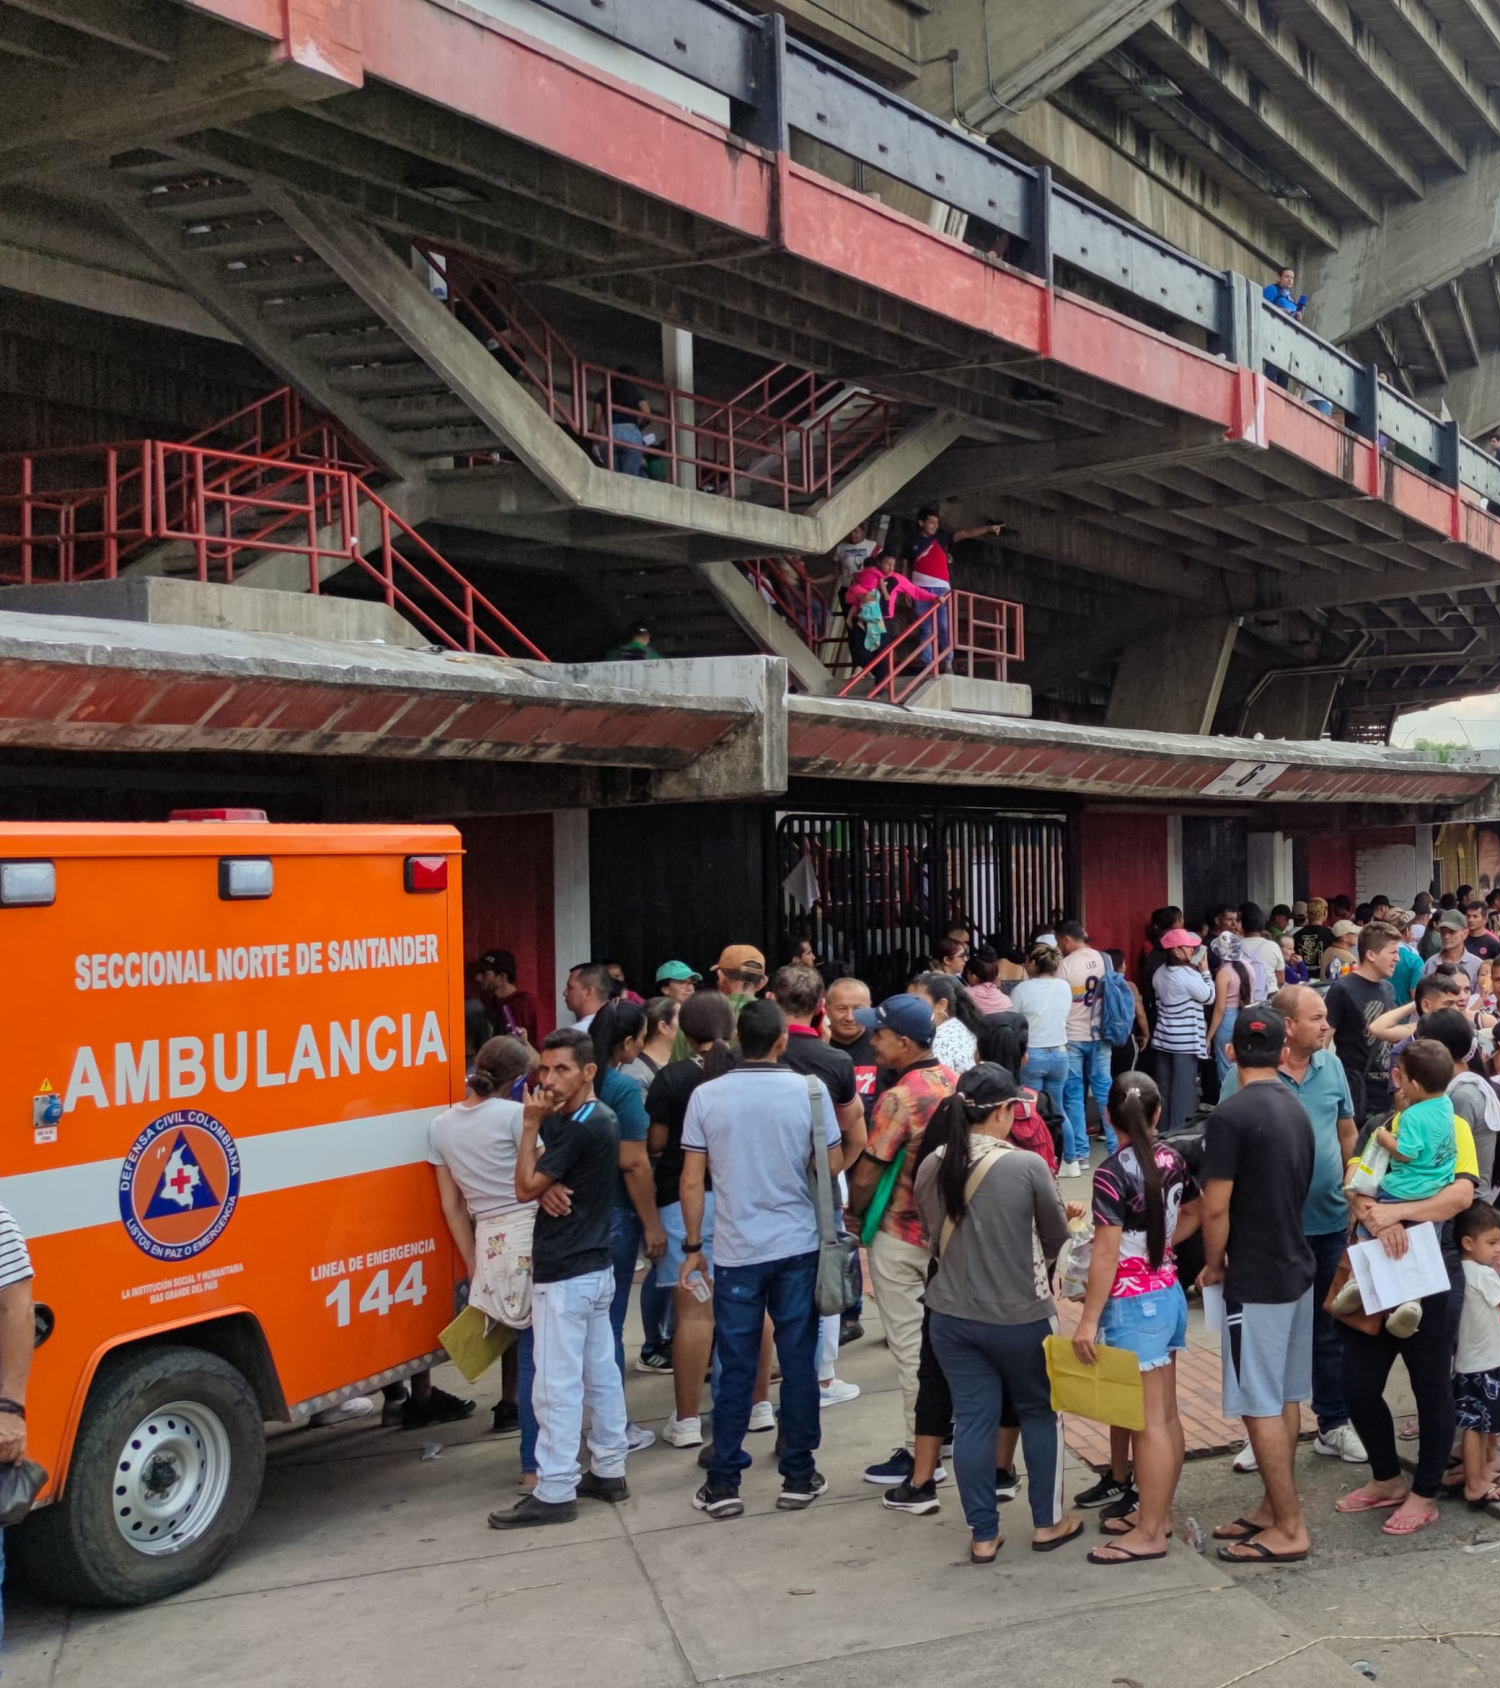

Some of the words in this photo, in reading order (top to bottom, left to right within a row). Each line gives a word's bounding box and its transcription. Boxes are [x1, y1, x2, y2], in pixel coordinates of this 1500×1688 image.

[1235, 763, 1267, 788] 6
[75, 949, 212, 991] SECCIONAL
[216, 944, 290, 982] NORTE
[296, 942, 323, 975] DE
[327, 933, 439, 973] SANTANDER
[63, 1010, 448, 1113] AMBULANCIA
[120, 1128, 156, 1192] DEFENSA
[155, 1111, 185, 1131] CIVIL
[187, 1110, 240, 1176] COLOMBIANA
[126, 1217, 152, 1250] LISTOS
[150, 1244, 164, 1257] EN
[164, 1247, 183, 1258] PAZ
[184, 1245, 192, 1256] O
[193, 1195, 237, 1252] EMERGENCIA
[121, 1289, 131, 1300] LA
[173, 1273, 196, 1288] SOCIAL
[196, 1272, 202, 1282] Y
[202, 1262, 244, 1280] HUMANITARIA
[310, 1259, 346, 1282] LINEA
[348, 1255, 364, 1272] DE
[366, 1237, 436, 1268] EMERGENCIA
[149, 1292, 165, 1305] MAS
[165, 1287, 191, 1301] GRANDE
[191, 1284, 203, 1295] DEL
[325, 1259, 427, 1328] 144
